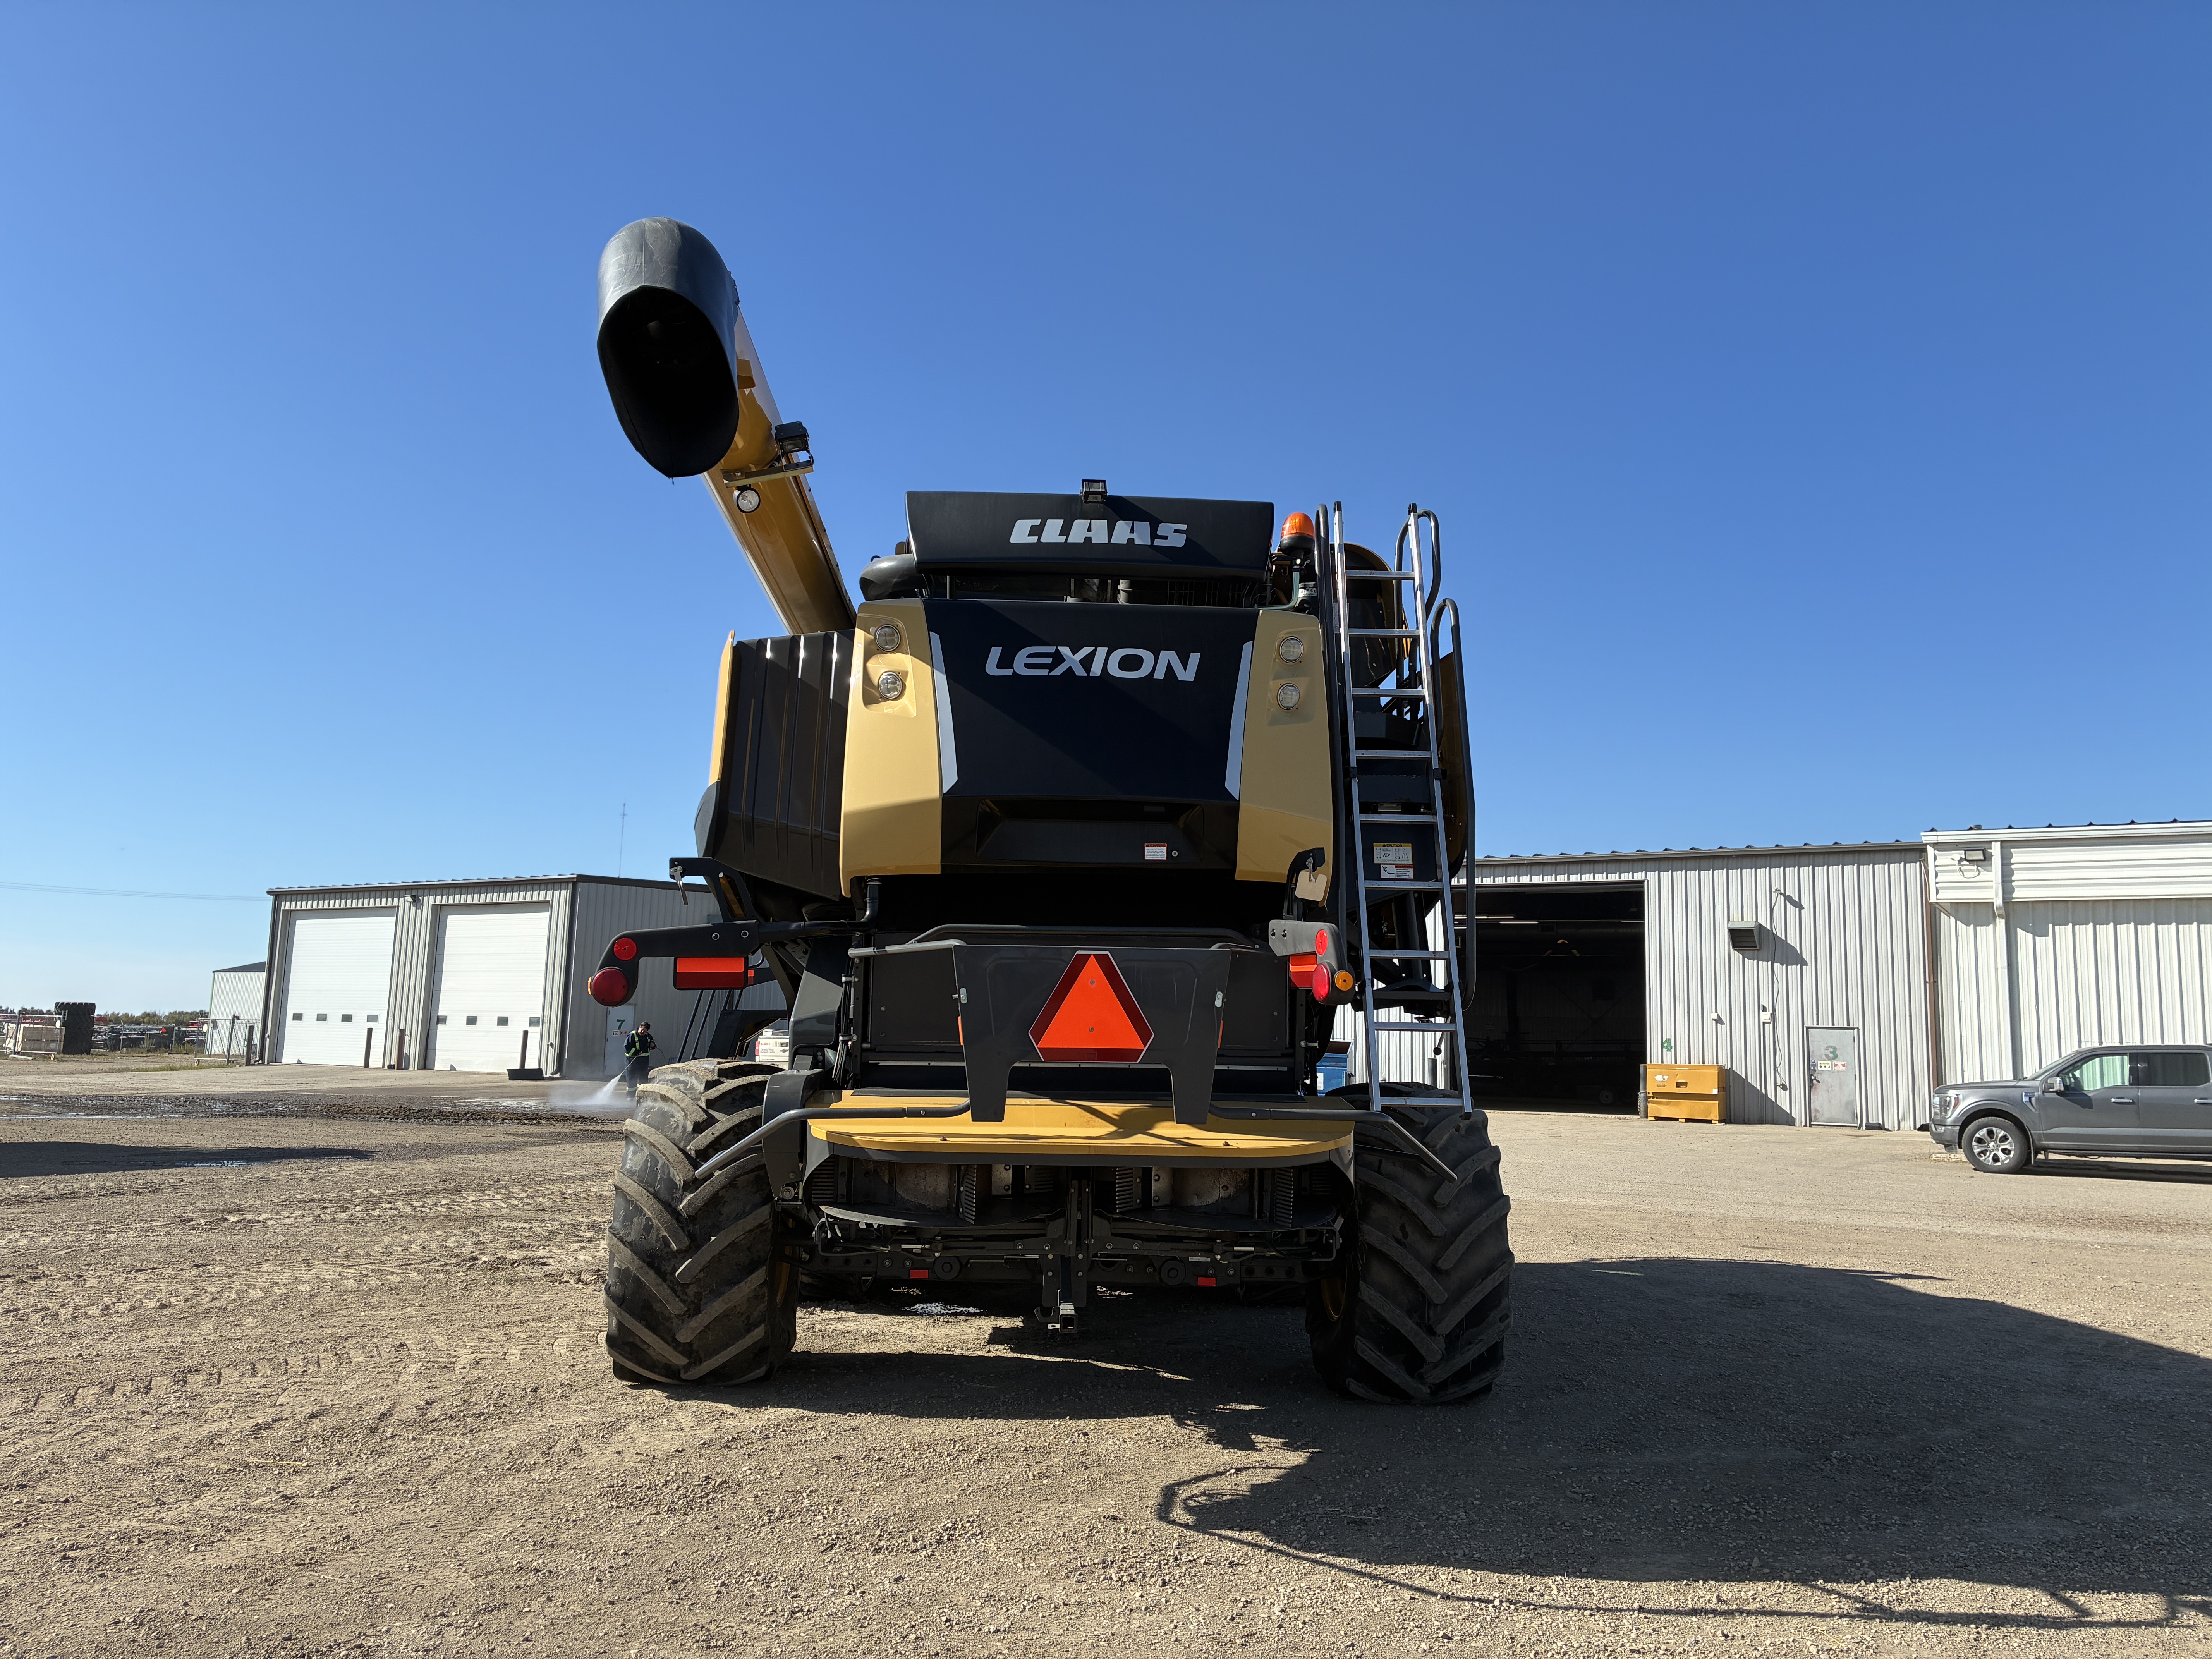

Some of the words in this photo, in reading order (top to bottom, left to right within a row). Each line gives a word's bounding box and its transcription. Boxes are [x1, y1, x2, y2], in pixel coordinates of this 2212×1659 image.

[1009, 519, 1188, 547] CLAAS
[985, 646, 1201, 681] LEXION
[617, 1019, 625, 1030] 7
[1661, 1038, 1673, 1052] 4
[1824, 1045, 1838, 1060] 3
